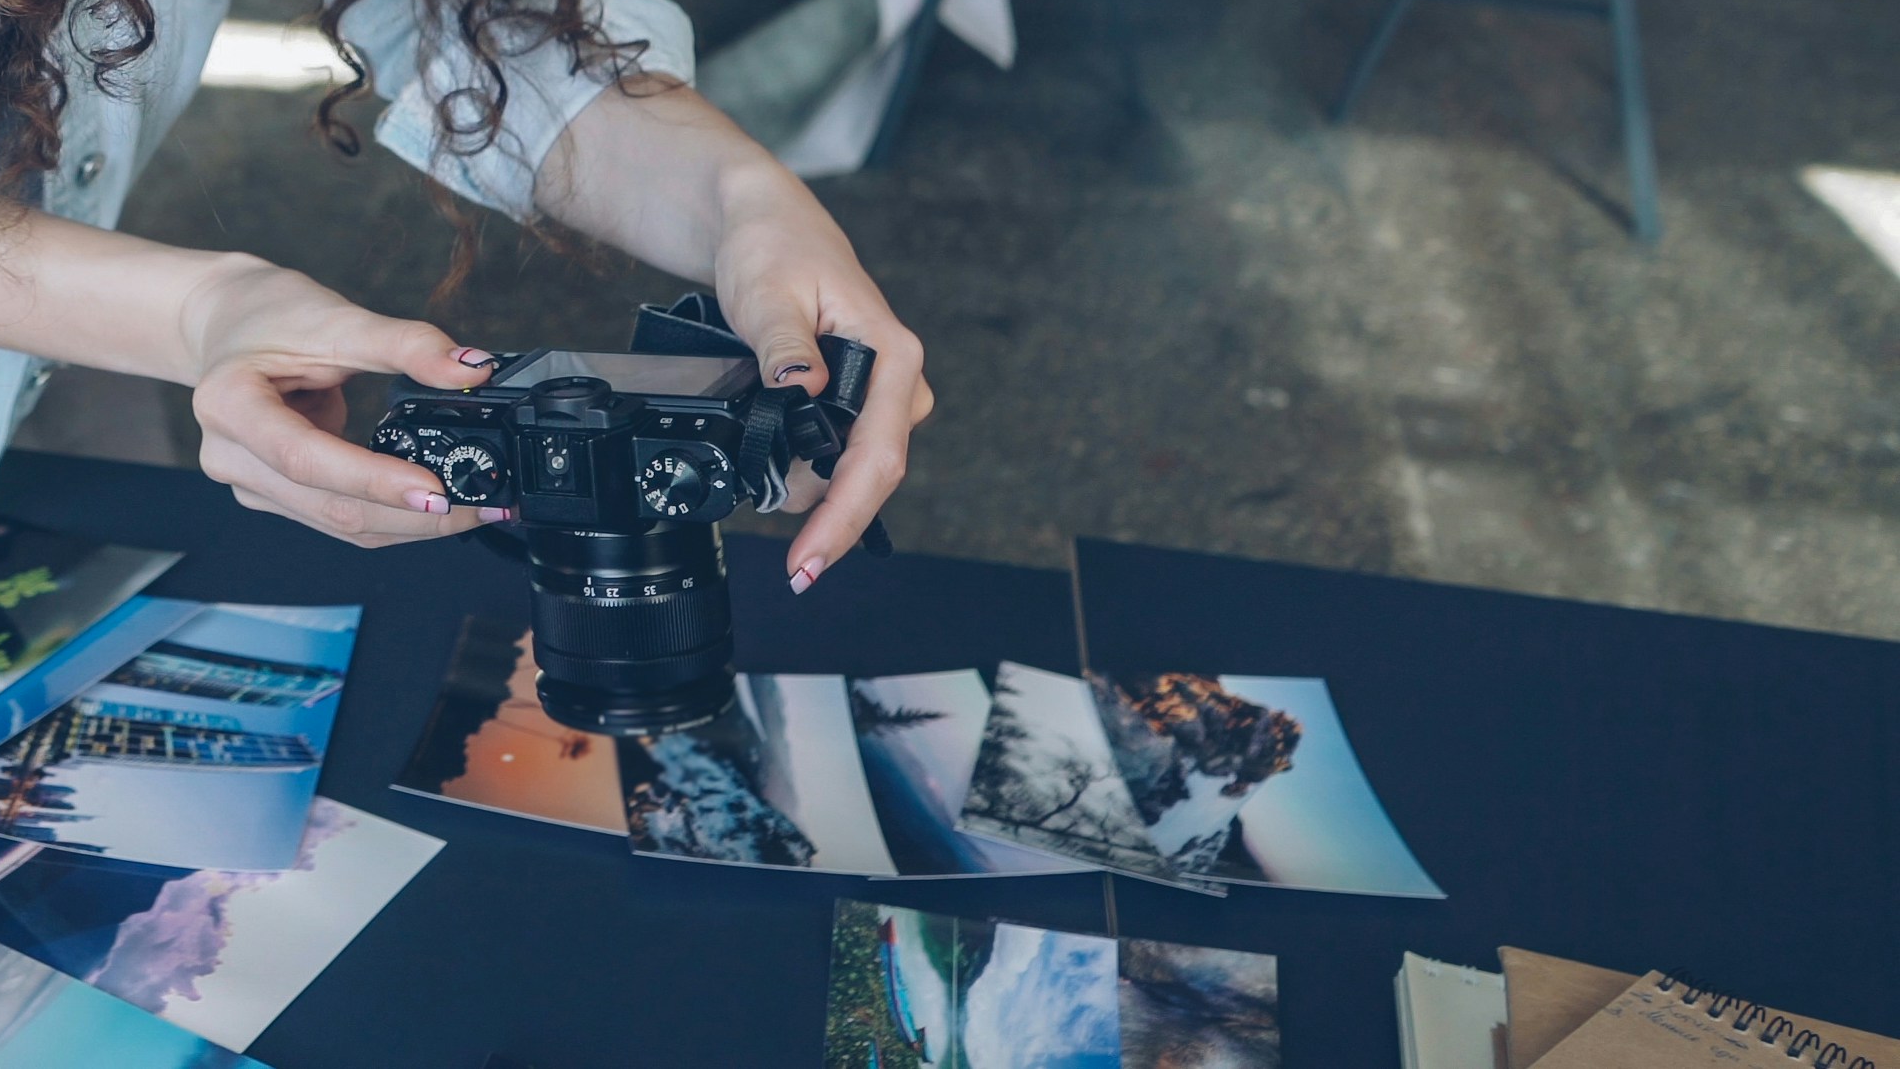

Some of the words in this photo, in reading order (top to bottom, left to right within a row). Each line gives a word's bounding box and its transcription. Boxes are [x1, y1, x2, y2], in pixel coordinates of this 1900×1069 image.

[583, 586, 596, 597] 16
[605, 587, 620, 598] 23
[643, 584, 657, 596] 35
[682, 577, 694, 589] 50
